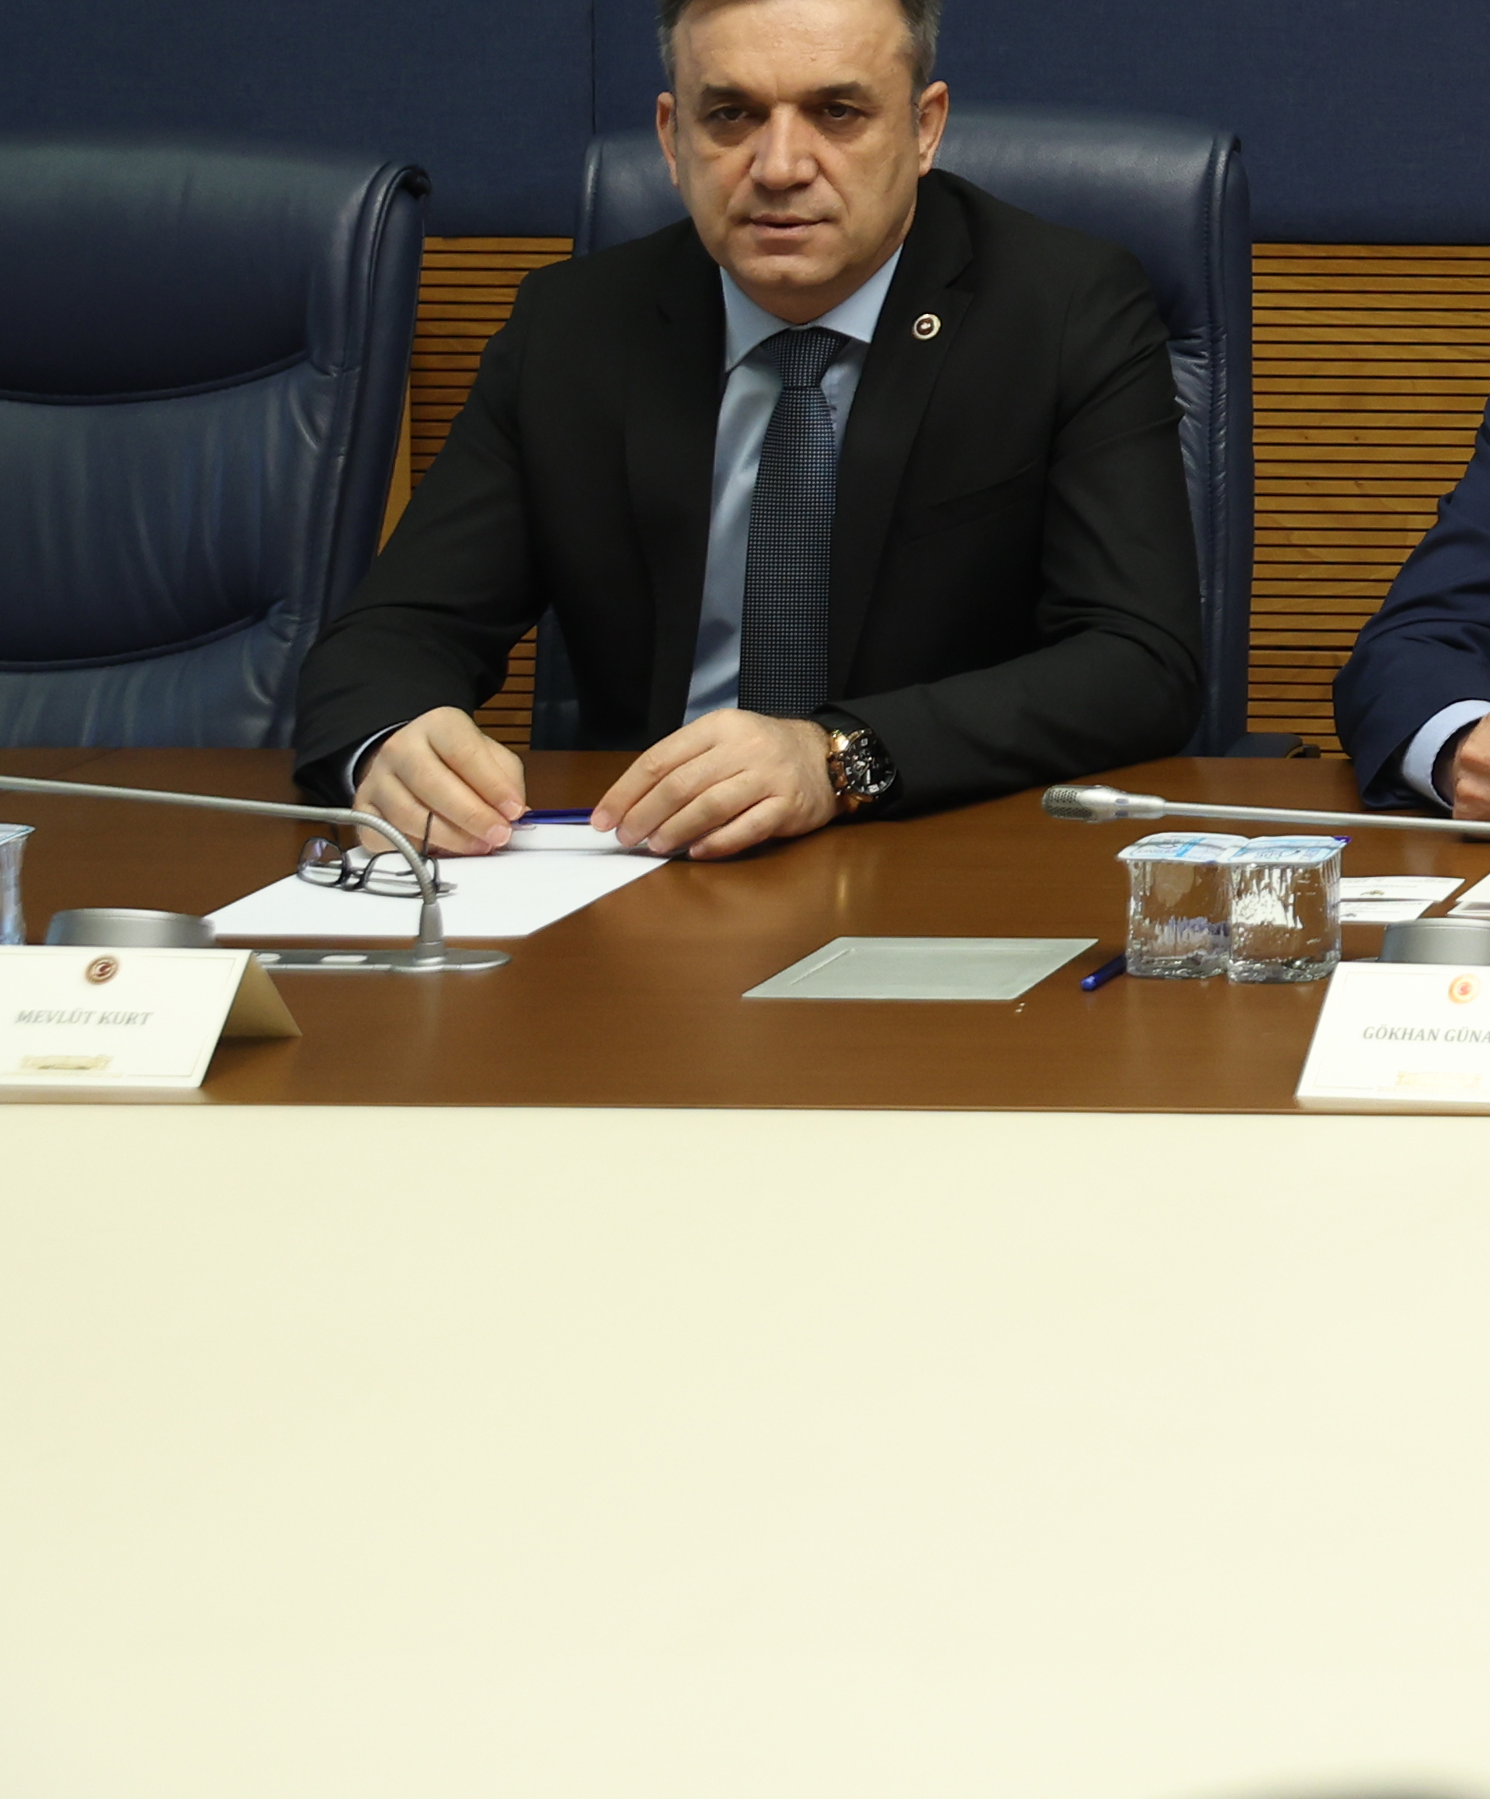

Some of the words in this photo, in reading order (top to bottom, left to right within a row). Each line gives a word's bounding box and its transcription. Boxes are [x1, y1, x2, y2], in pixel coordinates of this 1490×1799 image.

[16, 1008, 96, 1025] MEVLÜT
[98, 1011, 154, 1025] KURT
[1361, 1023, 1440, 1042] GÖKHAN
